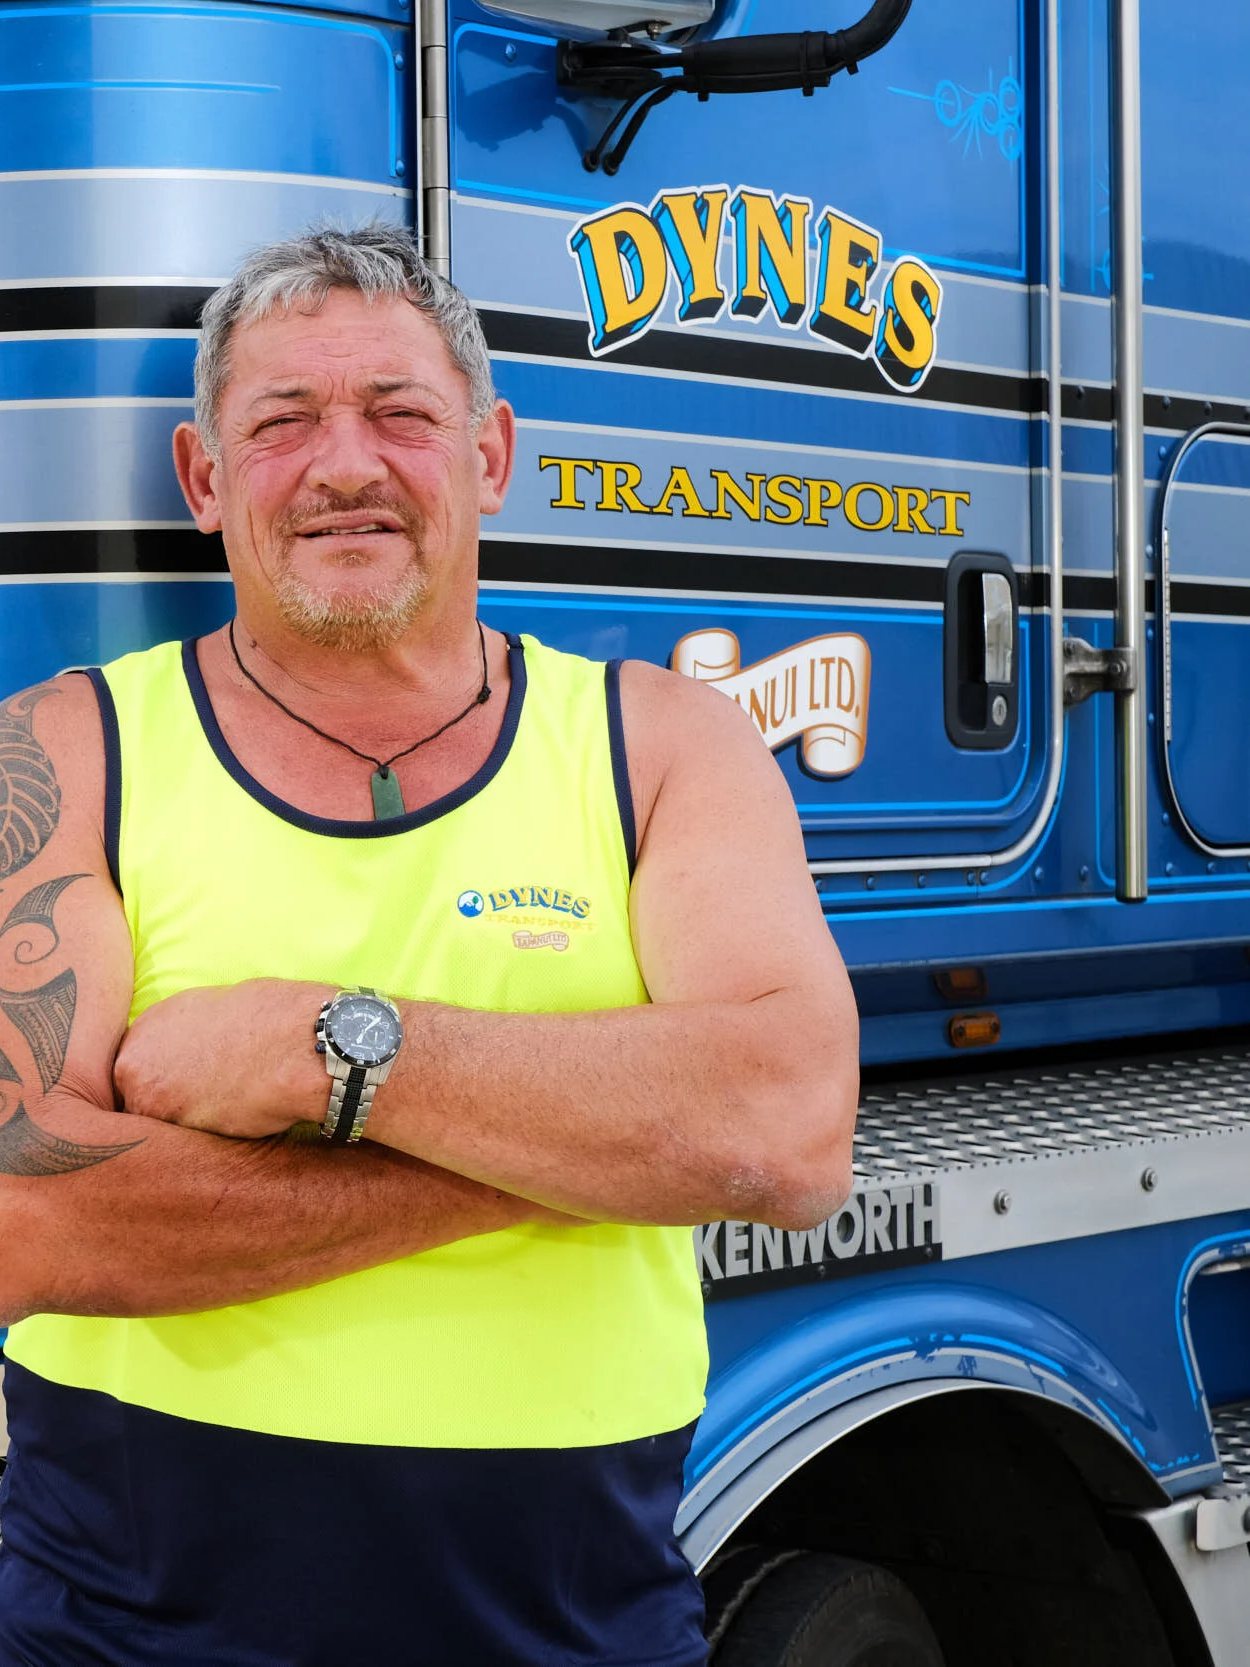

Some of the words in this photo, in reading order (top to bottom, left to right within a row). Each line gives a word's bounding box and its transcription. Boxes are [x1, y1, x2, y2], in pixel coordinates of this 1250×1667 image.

[567, 184, 942, 392] DYNES
[539, 455, 971, 537] TRANSPORT
[734, 664, 798, 735] NUI
[484, 913, 596, 931] TRANSPORT
[488, 886, 592, 919] DYNES
[692, 1183, 943, 1282] KENWORTH
